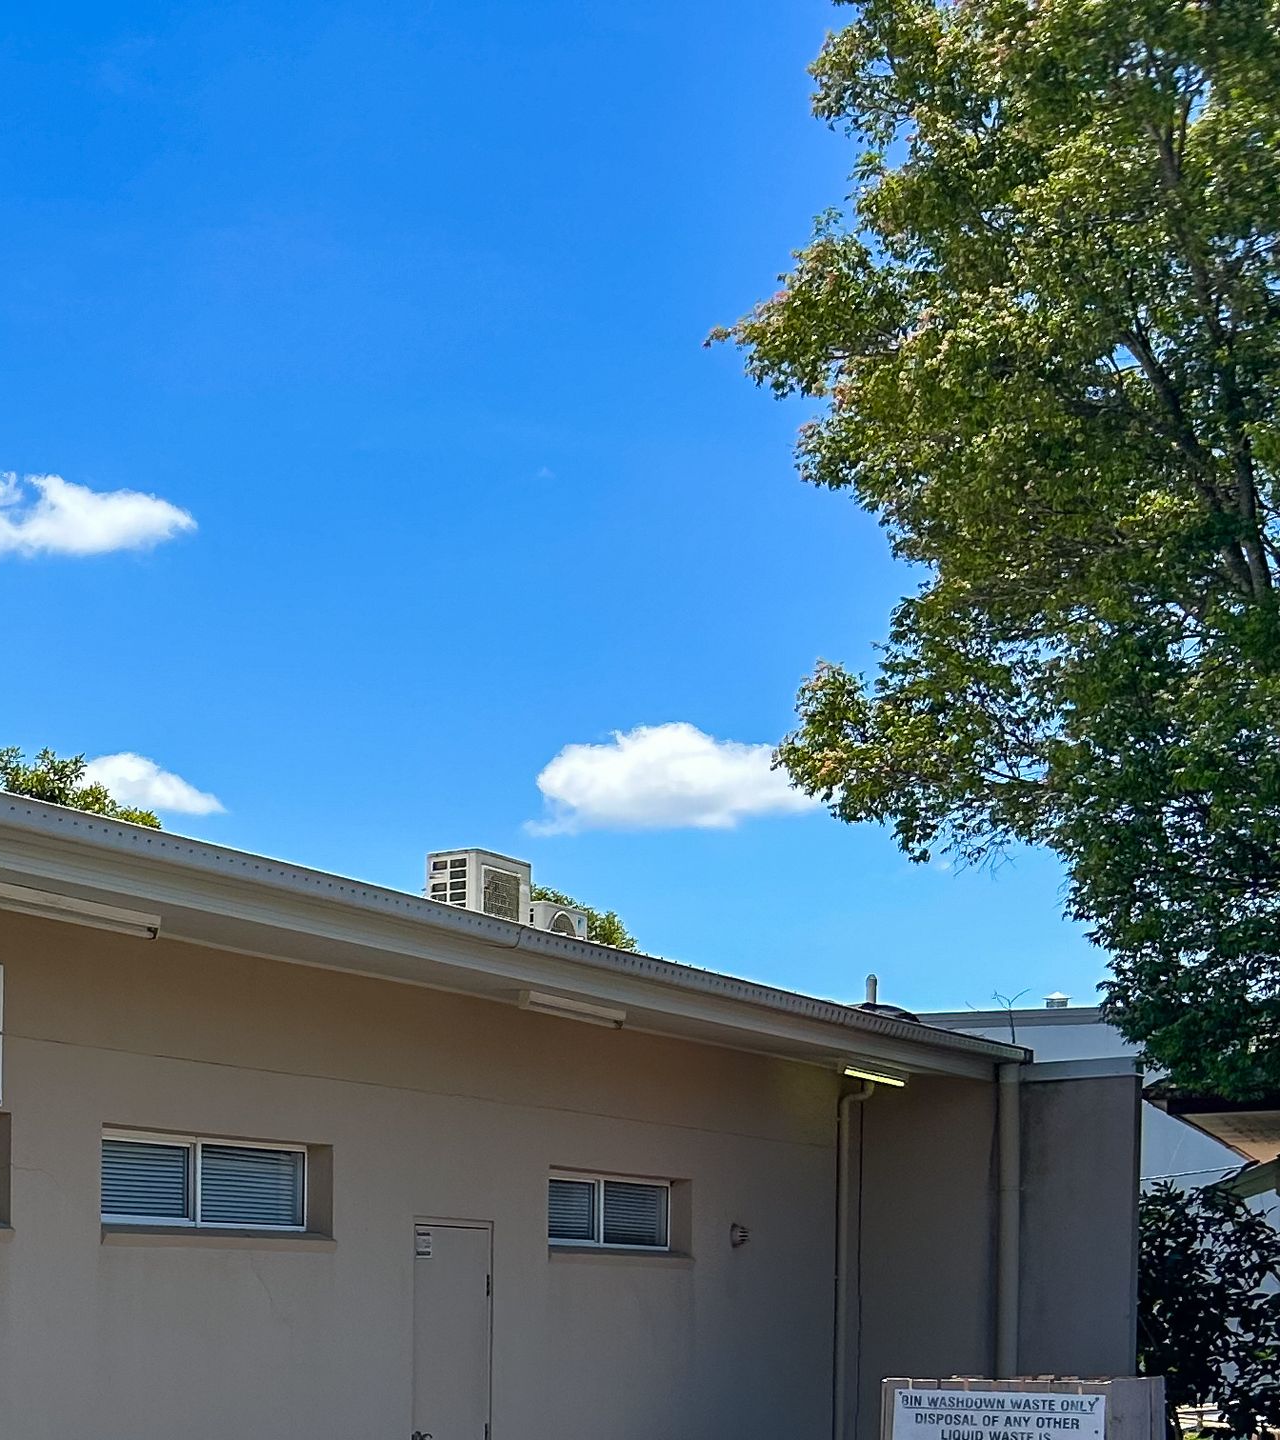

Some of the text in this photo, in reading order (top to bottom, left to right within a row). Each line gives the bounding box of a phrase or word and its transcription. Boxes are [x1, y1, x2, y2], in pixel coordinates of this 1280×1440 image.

[901, 1395, 1095, 1412] BIN WASHDOWN WASTE ONLY
[915, 1413, 1080, 1429] DISPOSAL OF ANY OTHER
